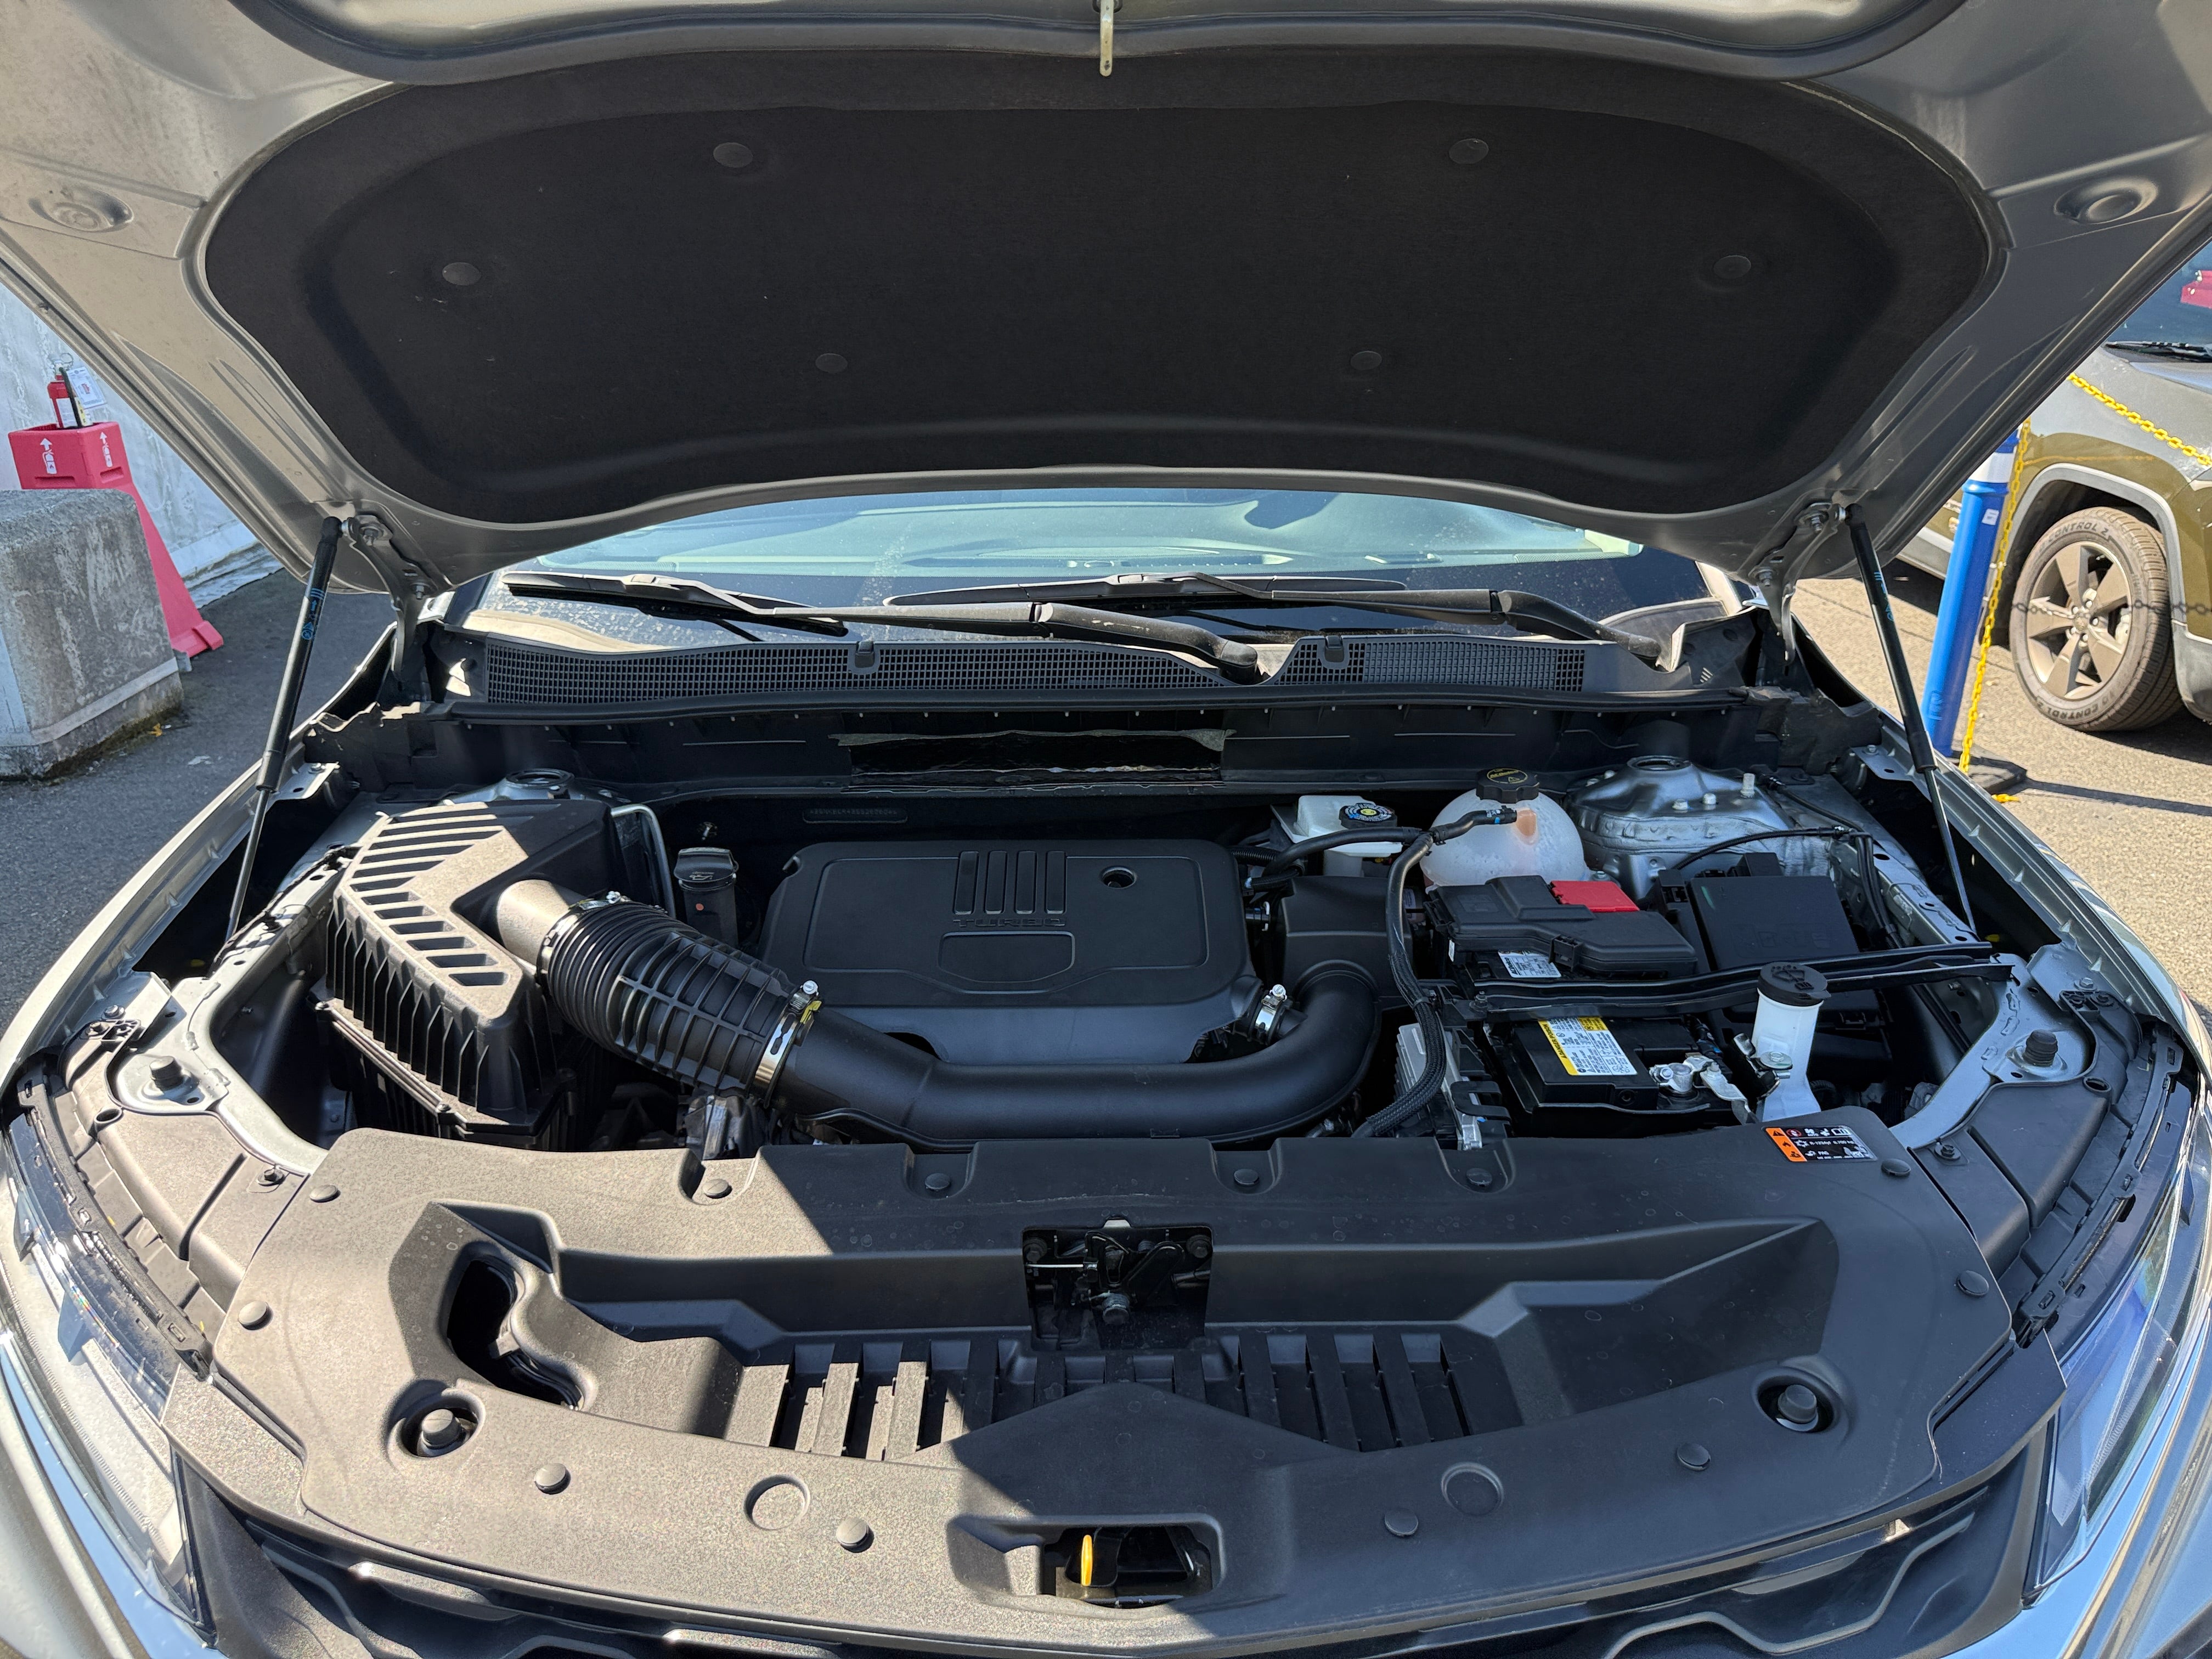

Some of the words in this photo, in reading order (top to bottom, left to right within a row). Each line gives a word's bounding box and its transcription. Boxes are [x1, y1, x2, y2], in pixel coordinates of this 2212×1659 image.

[2048, 521, 2098, 543] CONTROL
[2047, 703, 2098, 720] CONTROL
[952, 918, 1067, 927] TURBO
